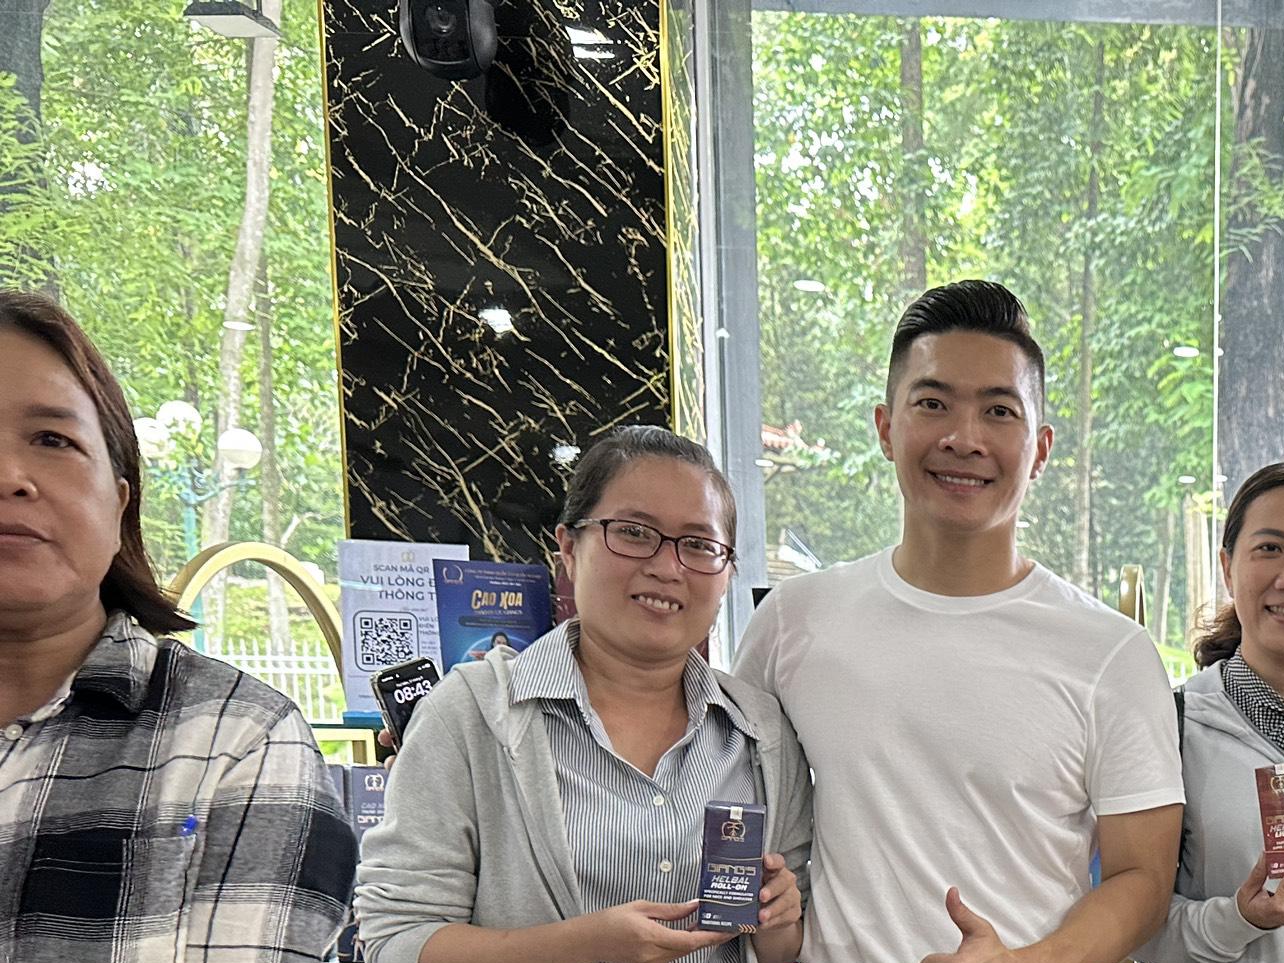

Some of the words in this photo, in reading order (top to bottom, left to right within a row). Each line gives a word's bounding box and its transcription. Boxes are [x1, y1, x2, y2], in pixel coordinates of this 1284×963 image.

[373, 564, 398, 572] SCAN
[416, 566, 430, 575] QR
[360, 575, 383, 586] VUI
[388, 574, 425, 588] LÒNG
[379, 587, 425, 601] THÔNG
[471, 589, 497, 610] CAO
[499, 591, 523, 610] XOA
[393, 679, 433, 704] 08:43
[710, 882, 748, 891] ROLL-ON
